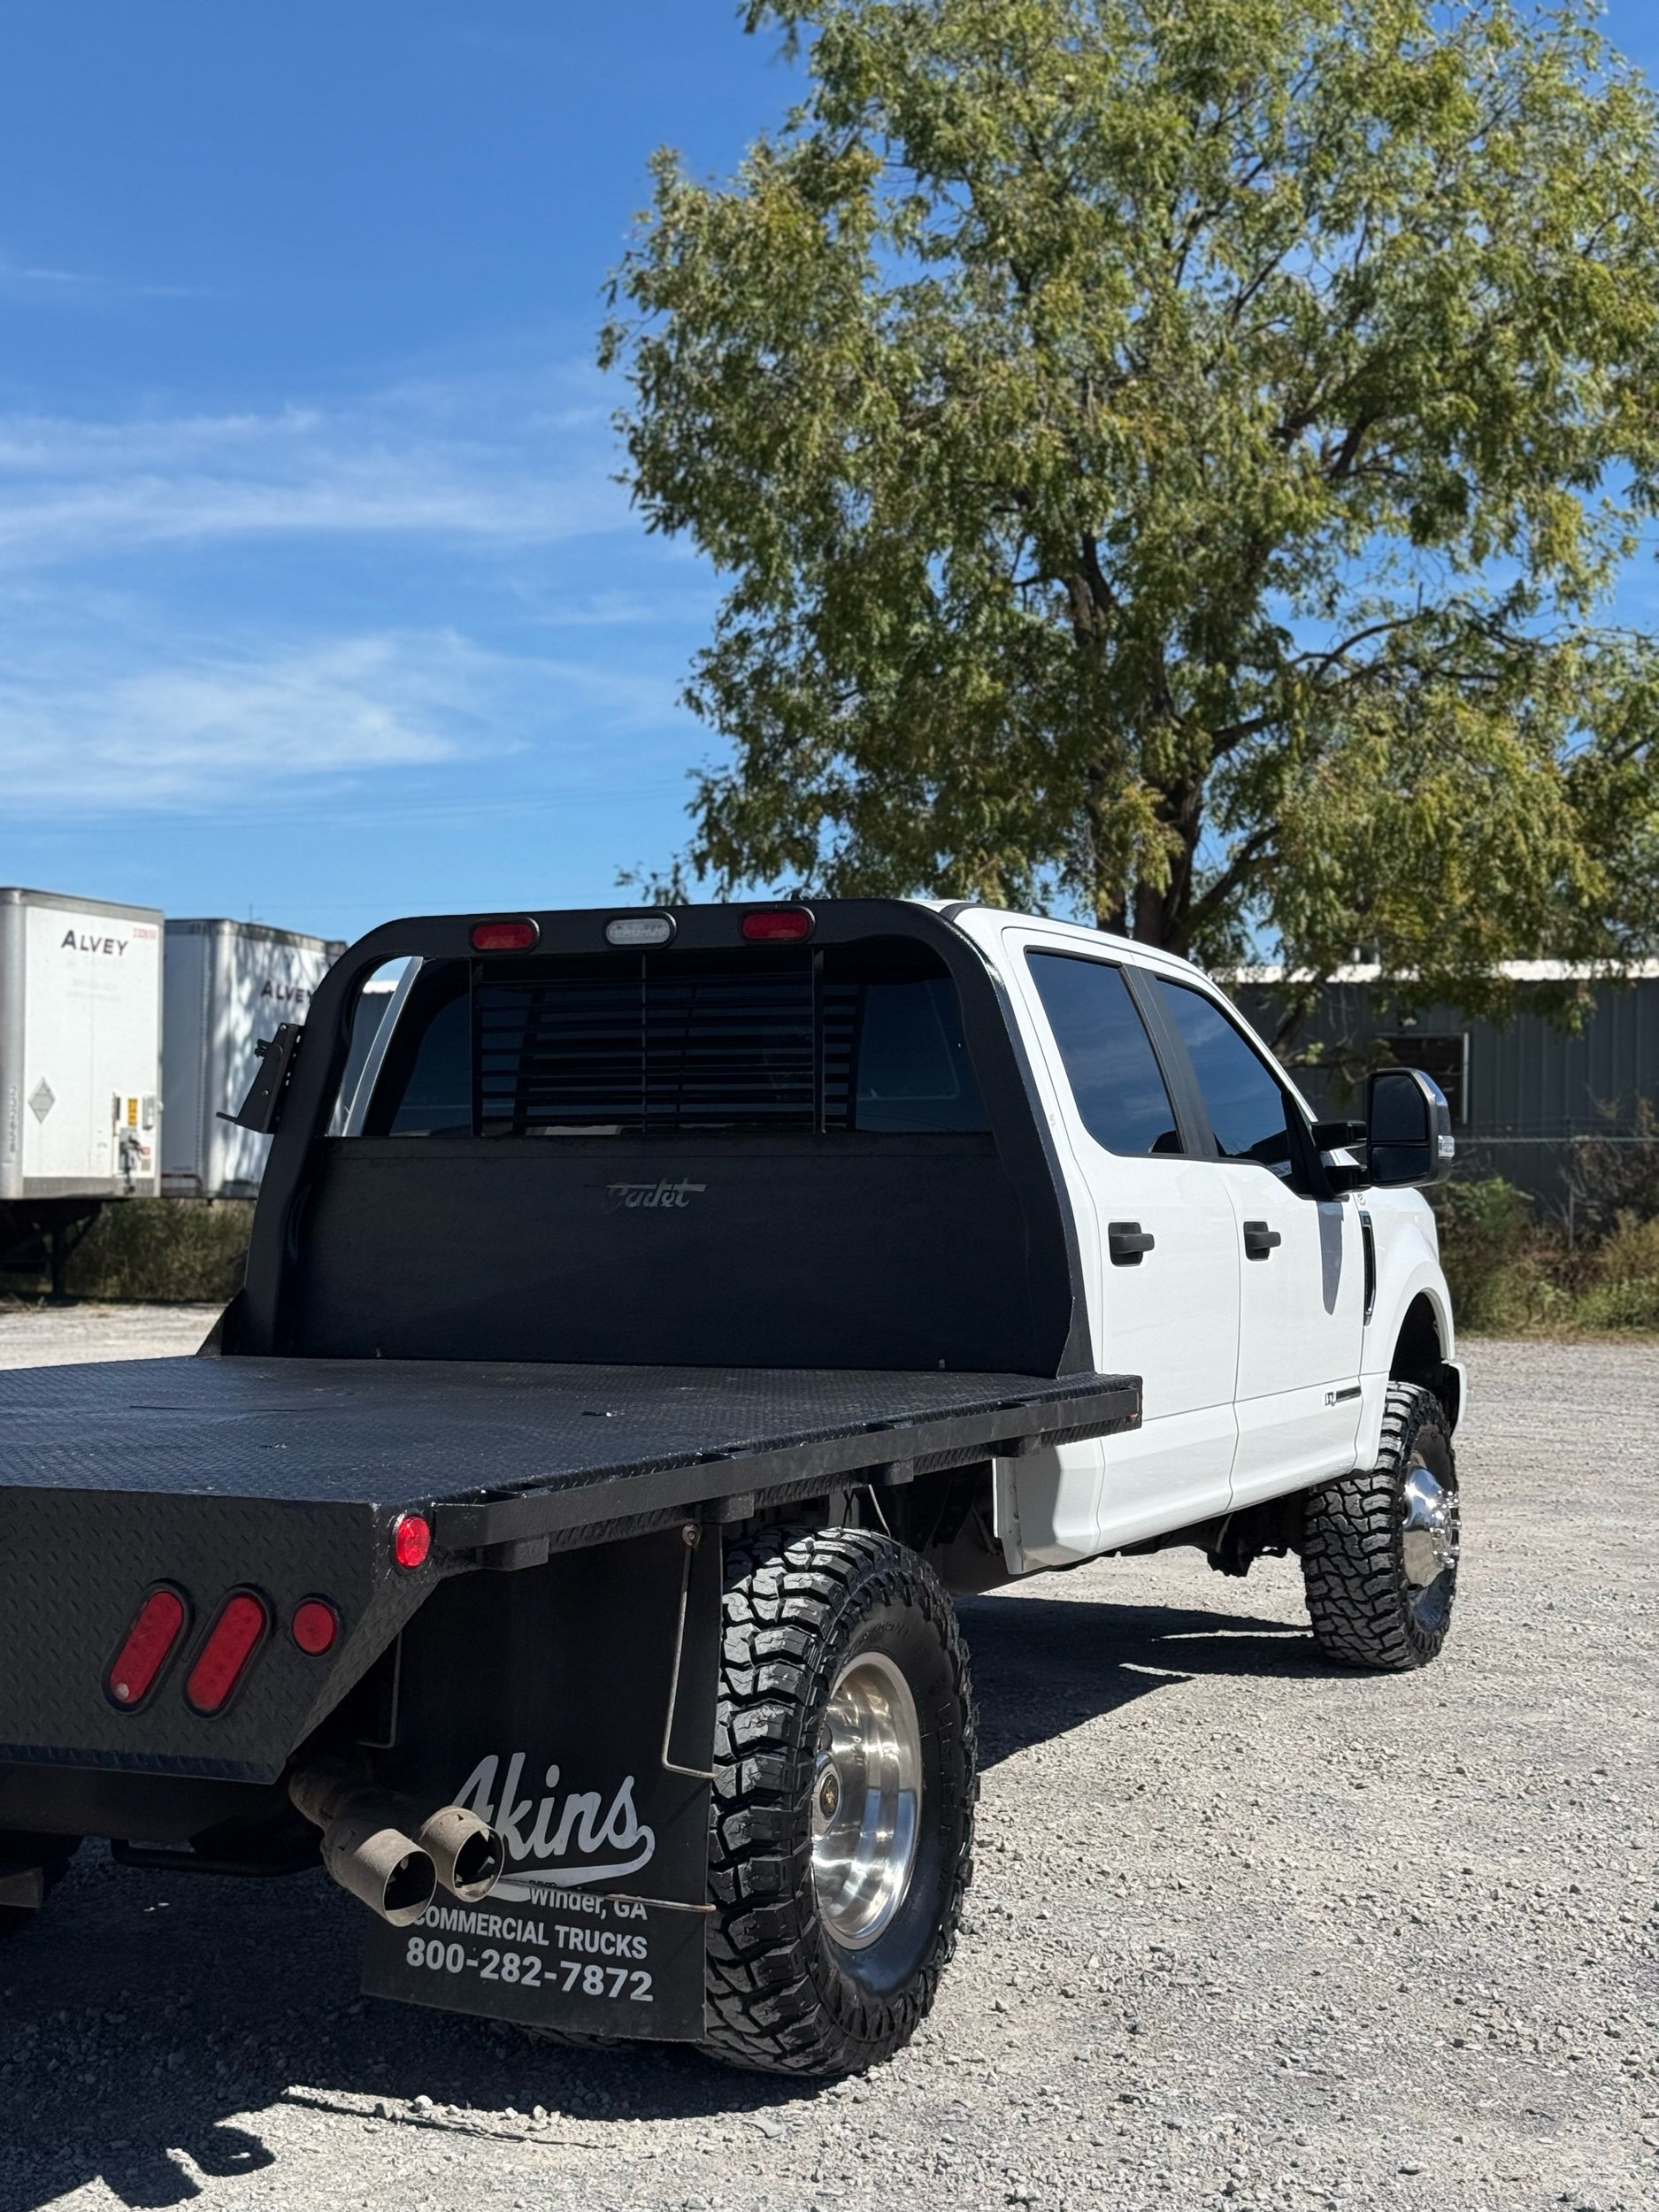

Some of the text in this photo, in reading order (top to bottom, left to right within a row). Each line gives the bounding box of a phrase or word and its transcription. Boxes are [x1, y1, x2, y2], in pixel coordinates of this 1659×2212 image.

[61, 929, 128, 956] ALVEY
[613, 1899, 649, 1921] GA
[554, 1924, 648, 1960] TRUCKS
[405, 1936, 654, 2002] 800-282-7872
